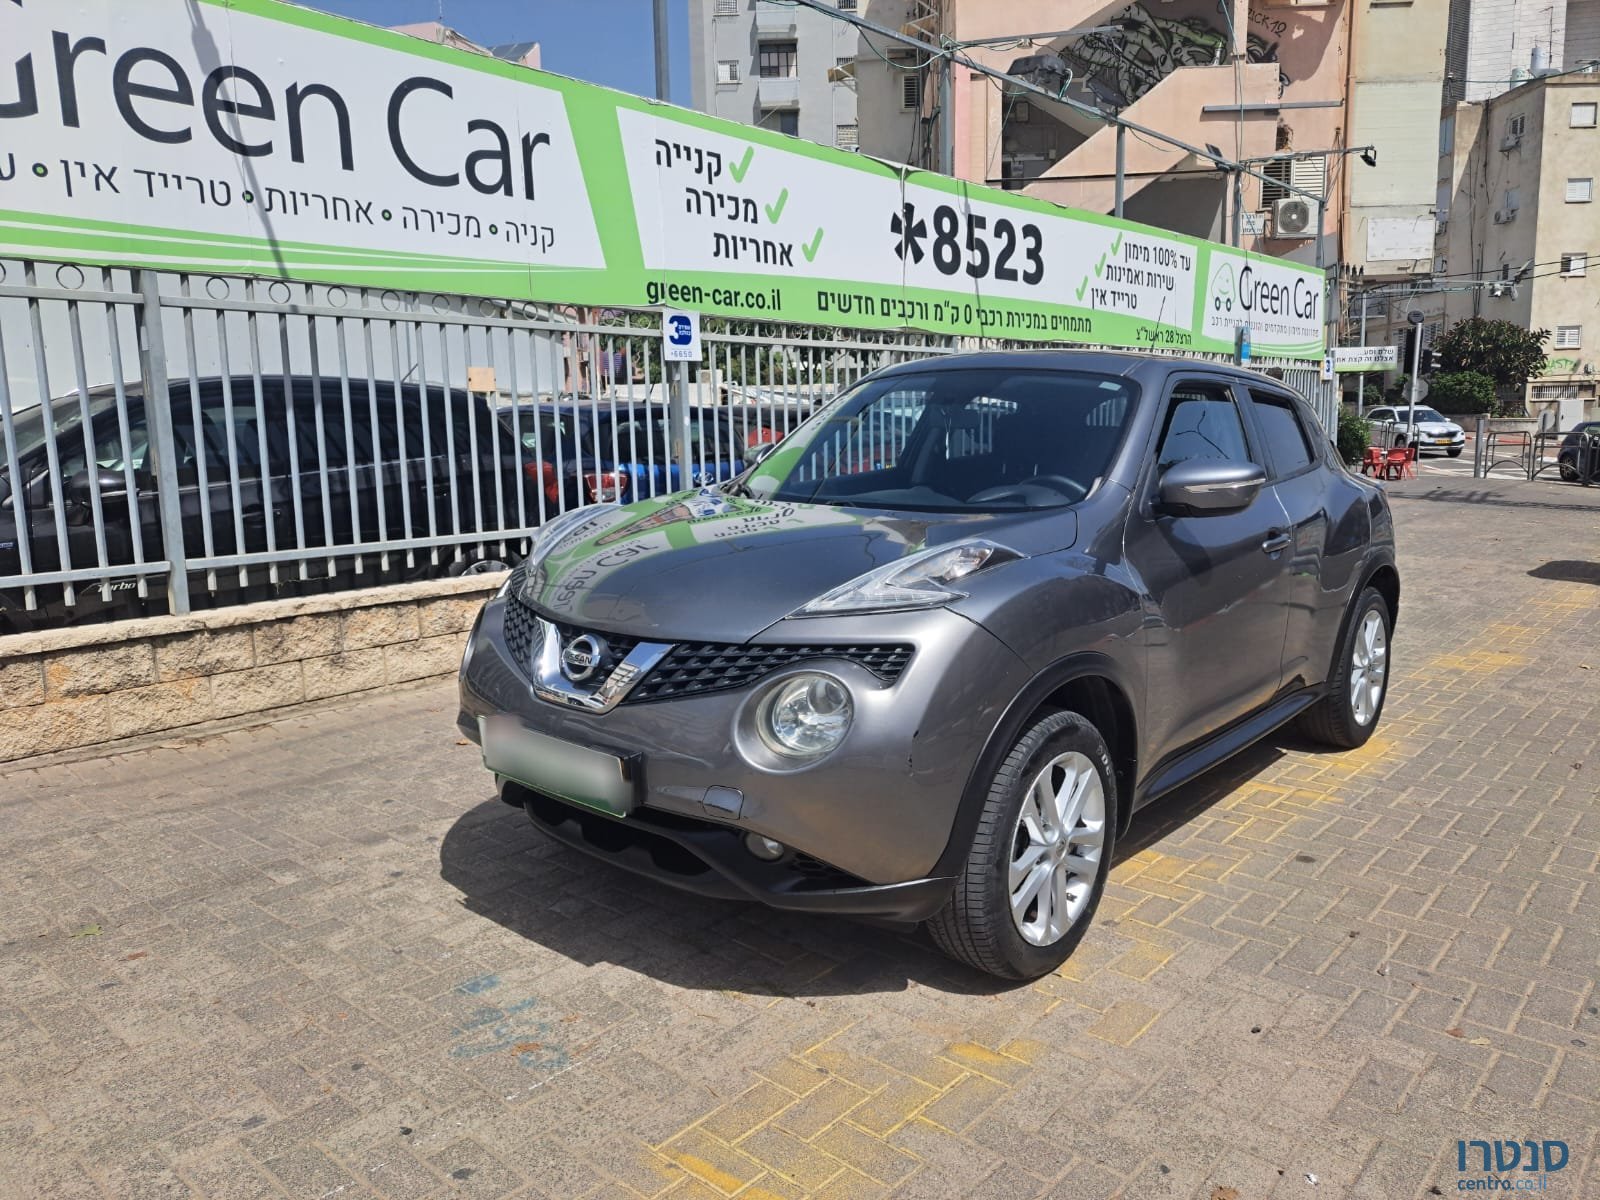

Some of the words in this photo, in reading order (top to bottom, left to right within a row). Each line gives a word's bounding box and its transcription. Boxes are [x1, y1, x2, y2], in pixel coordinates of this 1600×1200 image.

[387, 76, 552, 201] Car
[655, 139, 722, 185] קנייה
[60, 160, 120, 197] אין
[134, 169, 232, 206] טרייד
[264, 187, 374, 224] אחריות
[686, 187, 758, 224] מכירה
[402, 206, 481, 239] מכירה
[505, 221, 555, 253] קניה
[713, 232, 793, 267] אחריות
[1125, 242, 1149, 264] מימון
[1153, 246, 1177, 269] 100%
[1106, 263, 1144, 286] ואמינות
[1180, 255, 1191, 271] עד
[1147, 271, 1174, 291] שירות
[1239, 265, 1290, 317] Green
[1294, 277, 1319, 320] Car
[646, 281, 781, 310] green-car.co.il
[817, 291, 875, 315] חדשים
[1091, 288, 1107, 310] אין
[1111, 290, 1137, 309] טרייד
[880, 298, 928, 320] ורכבים
[964, 304, 972, 324] 0
[976, 309, 1003, 327] רכבי
[1006, 311, 1048, 331] במכירת
[1051, 315, 1092, 333] מתמחים
[1165, 329, 1174, 343] 28
[1175, 330, 1192, 345] הרצל
